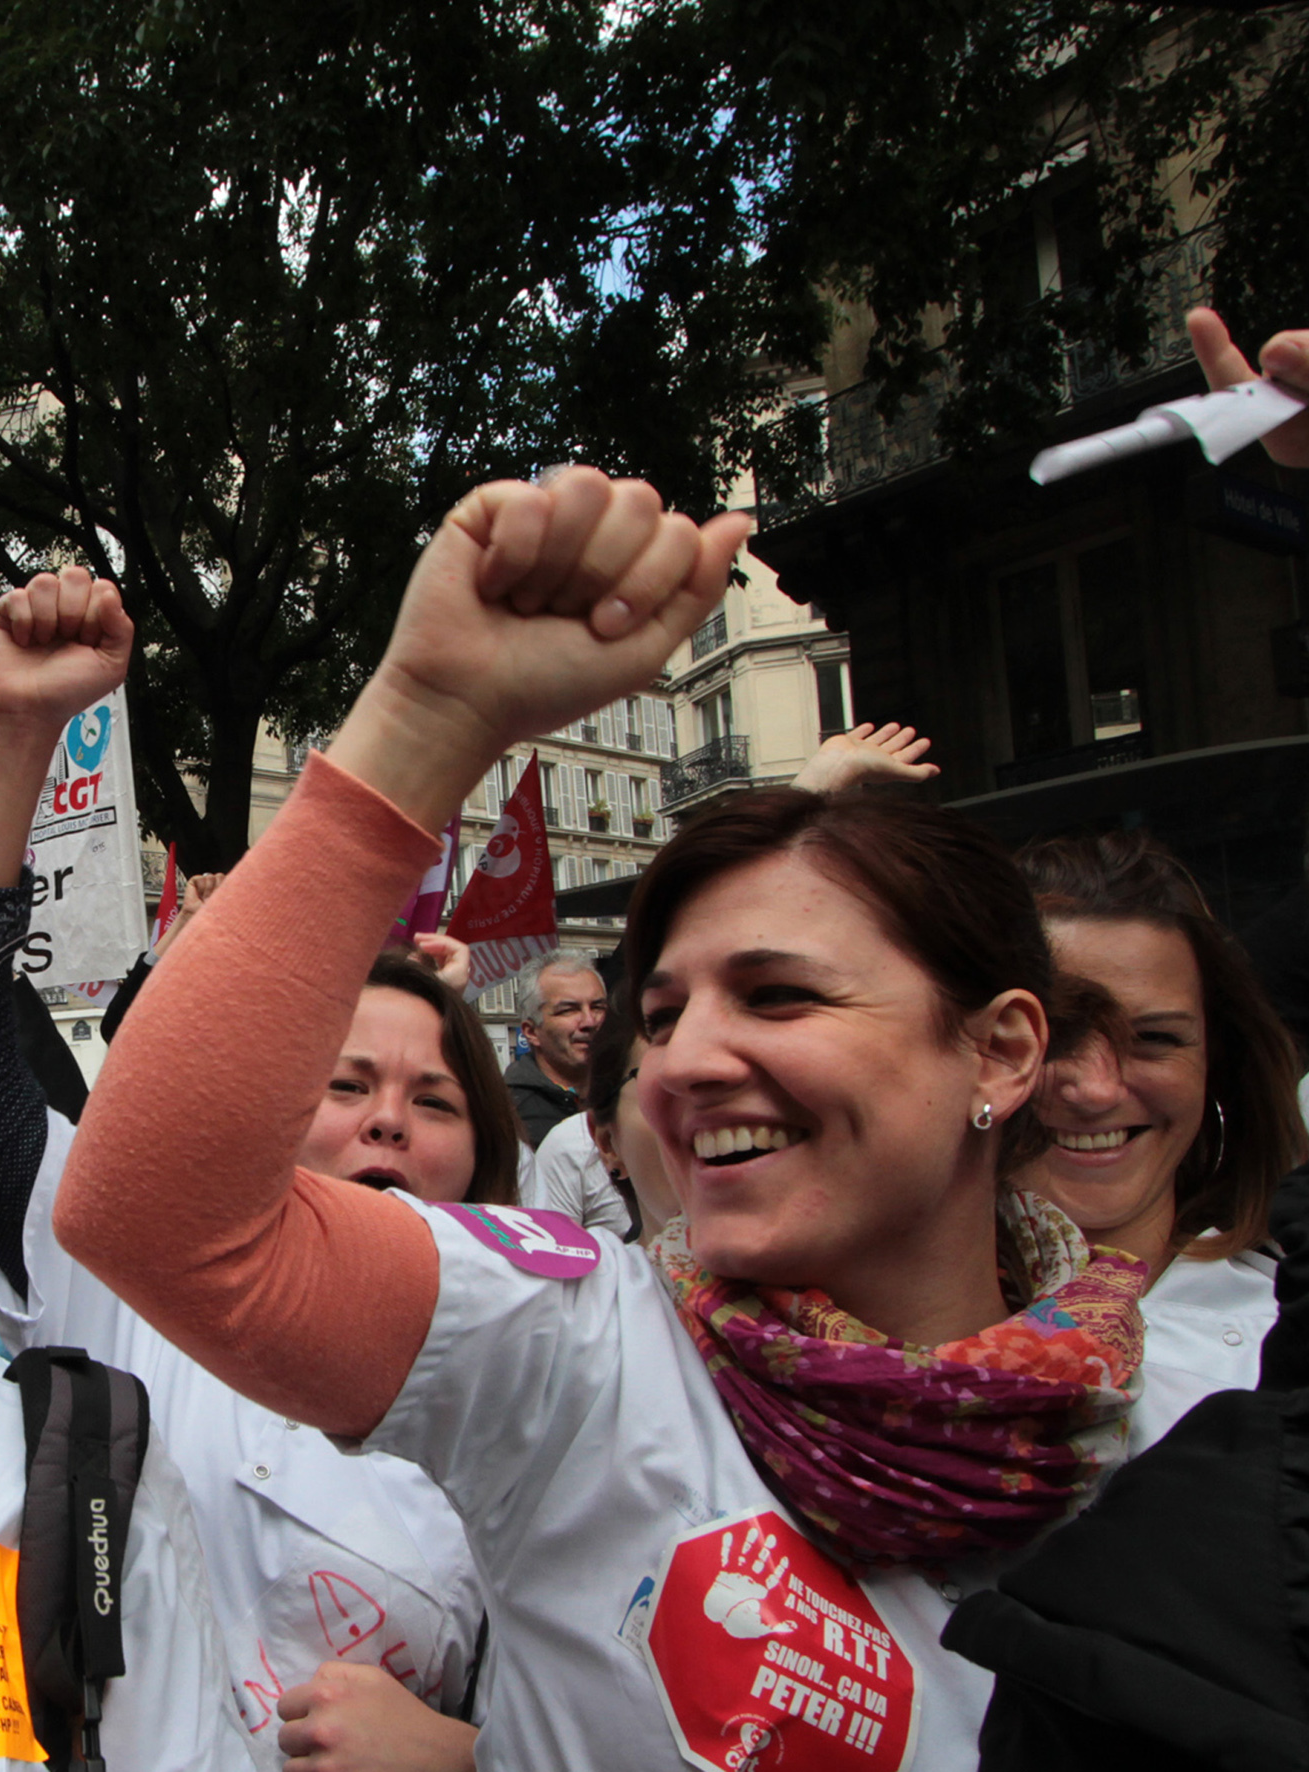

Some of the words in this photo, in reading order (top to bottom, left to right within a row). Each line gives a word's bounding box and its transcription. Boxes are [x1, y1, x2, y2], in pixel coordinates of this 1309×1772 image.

[53, 772, 103, 814] CGT
[88, 1498, 113, 1616] Quechua
[788, 1573, 804, 1596] NE
[805, 1585, 863, 1633] TOUCHEZ
[864, 1622, 891, 1649] PAS
[796, 1599, 818, 1624] NOS
[824, 1617, 891, 1681] R.T.T
[750, 1665, 846, 1737] PETER
[864, 1690, 888, 1719] VA
